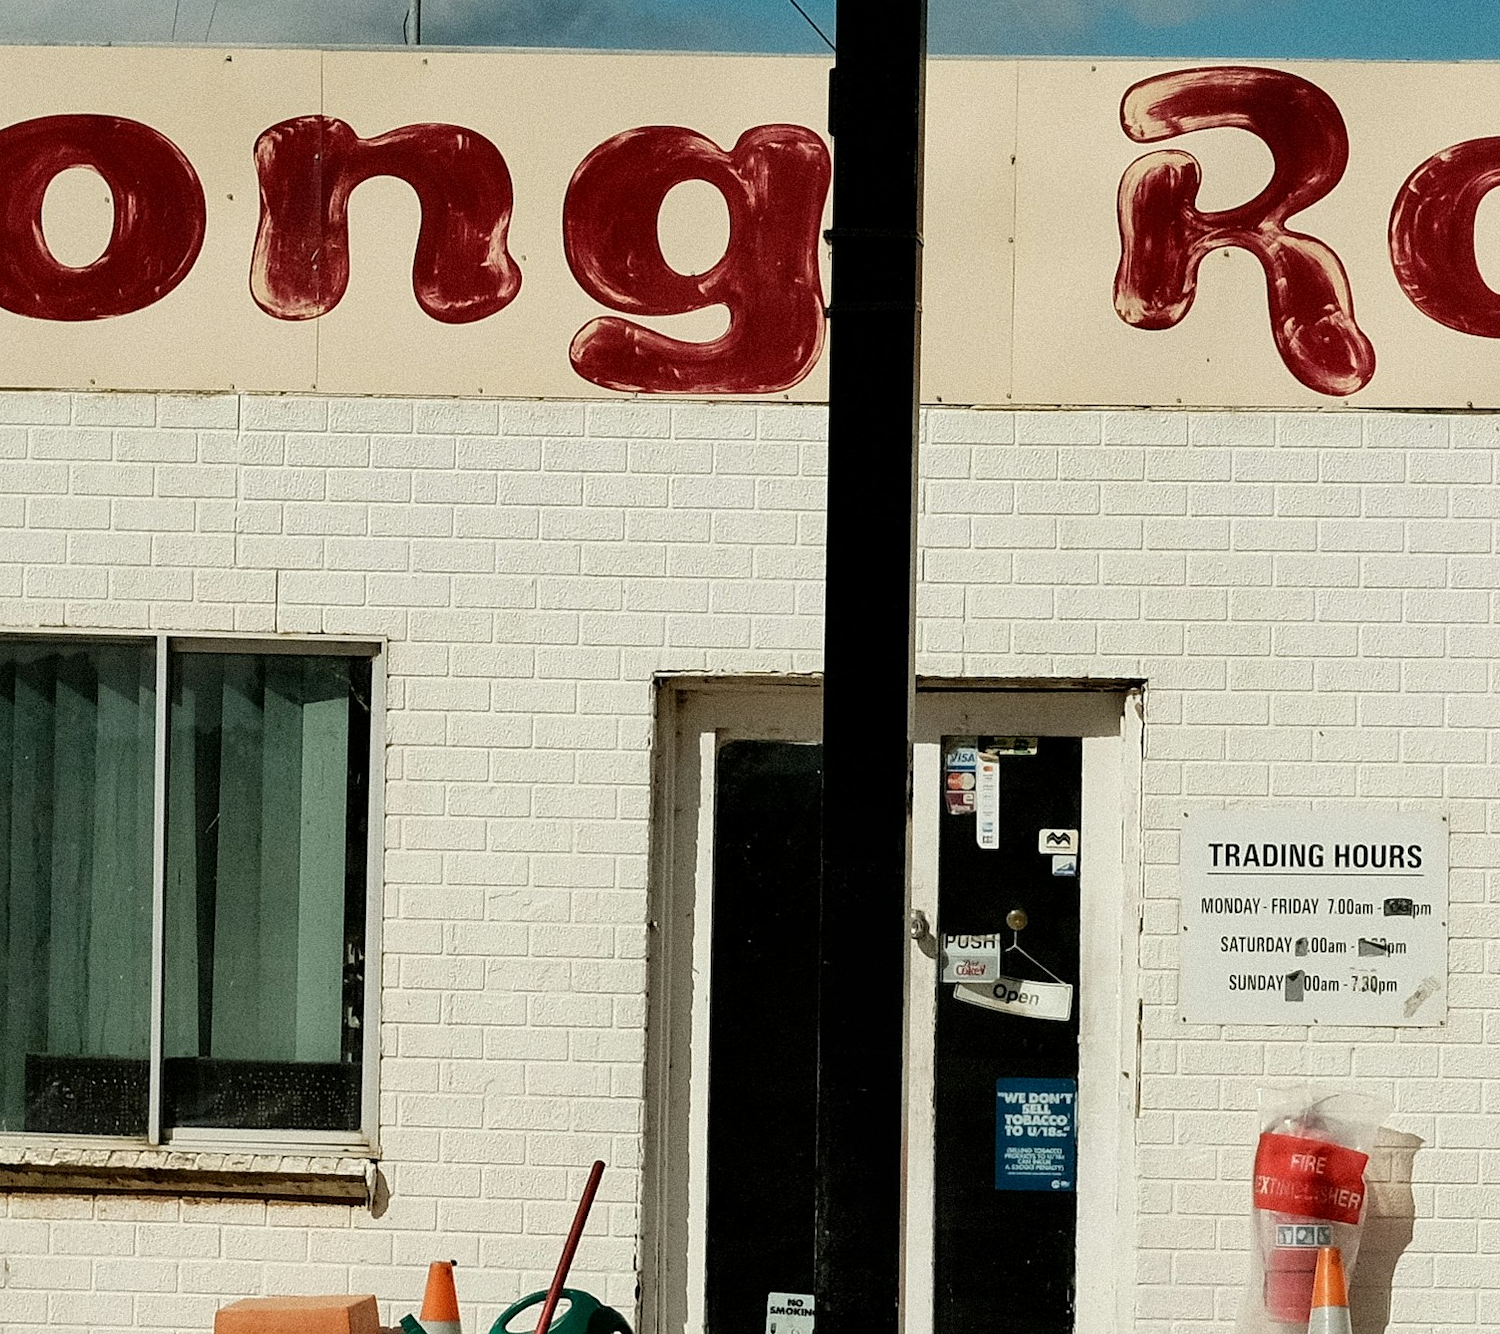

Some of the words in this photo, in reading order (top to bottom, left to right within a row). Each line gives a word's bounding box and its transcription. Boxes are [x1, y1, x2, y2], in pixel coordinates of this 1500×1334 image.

[949, 750, 975, 763] VISA
[1208, 844, 1324, 868] TRADING
[1334, 844, 1423, 868] HOURS
[1201, 898, 1261, 914] MONDAY
[1271, 898, 1319, 914] FRIDAY
[1328, 898, 1374, 915] 7.00am
[945, 935, 996, 949] PUSH
[1220, 937, 1292, 953] SATURDAY
[1229, 975, 1284, 991] SUNDAY
[993, 984, 1040, 1006] Open
[1028, 1092, 1073, 1104] DON'T
[1022, 1104, 1051, 1114] SELL
[1004, 1114, 1069, 1126] TOBACCO
[1004, 1126, 1024, 1136] TO
[1290, 1154, 1328, 1174] FIRE
[787, 1299, 803, 1307] NO
